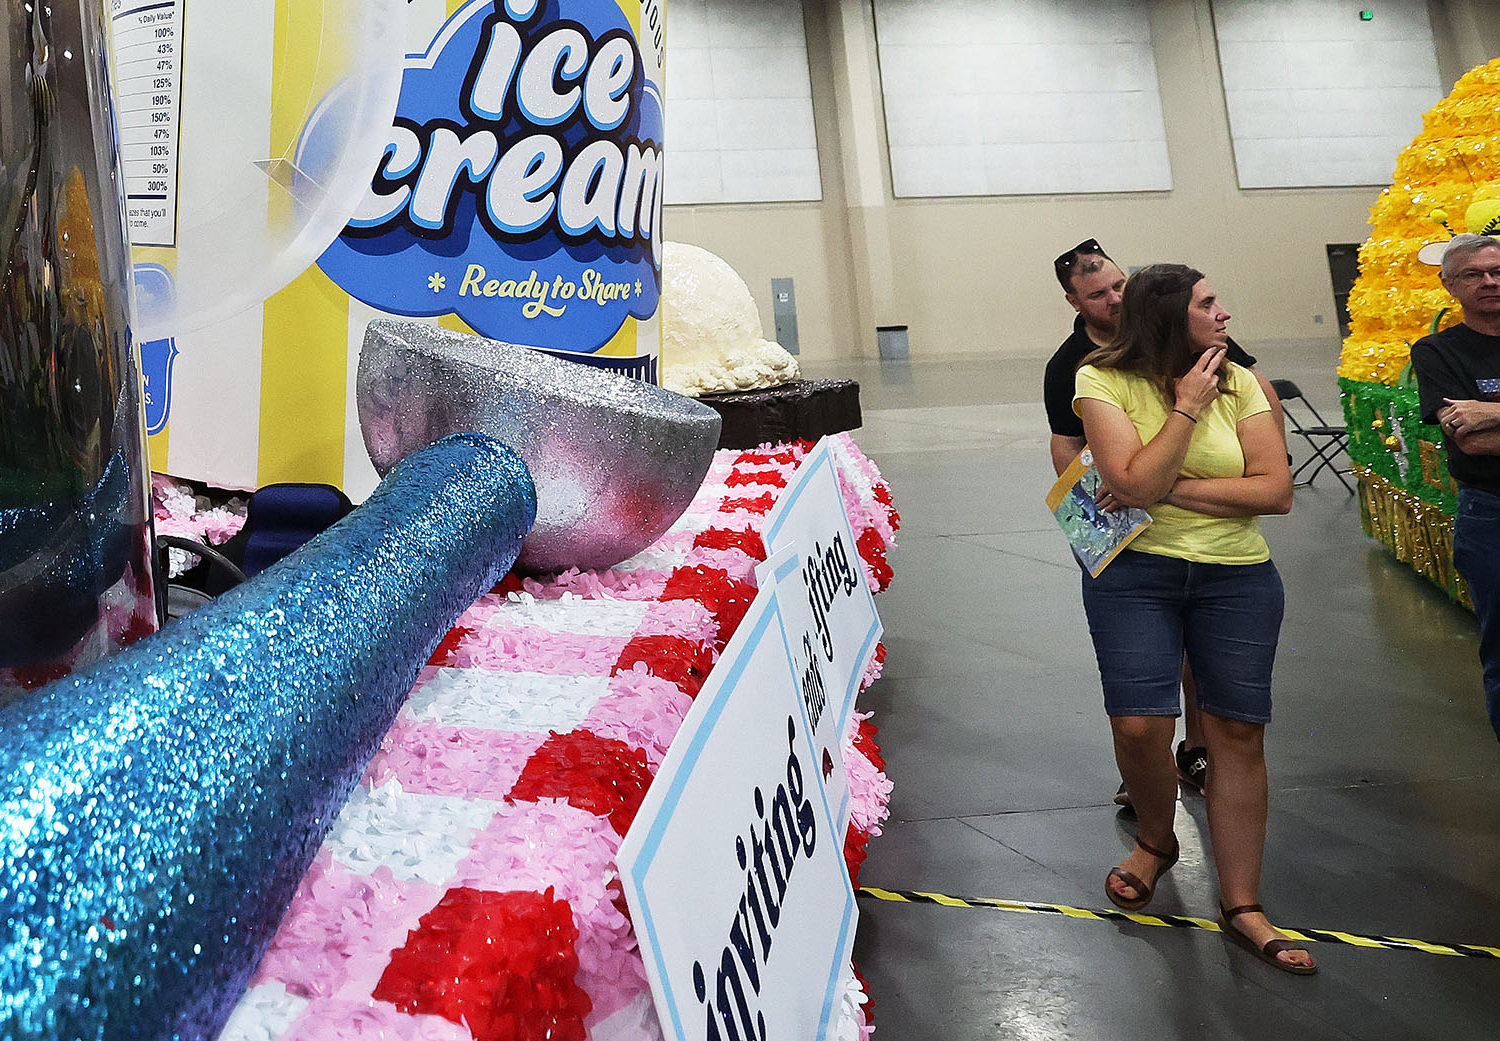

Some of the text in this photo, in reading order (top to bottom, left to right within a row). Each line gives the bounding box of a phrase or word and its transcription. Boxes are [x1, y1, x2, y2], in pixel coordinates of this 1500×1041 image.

[154, 27, 174, 38] 100%
[157, 43, 174, 54] 43%
[156, 60, 173, 71] 47%
[153, 78, 172, 88] 125%
[152, 95, 171, 105] 190%
[151, 112, 170, 123] 150%
[153, 129, 170, 139] 47%
[150, 146, 169, 156] 103%
[152, 163, 169, 174] 50%
[147, 181, 168, 191] 300%
[346, 126, 663, 272] cream
[459, 264, 631, 319] Ready to Share
[803, 530, 858, 663] ifting
